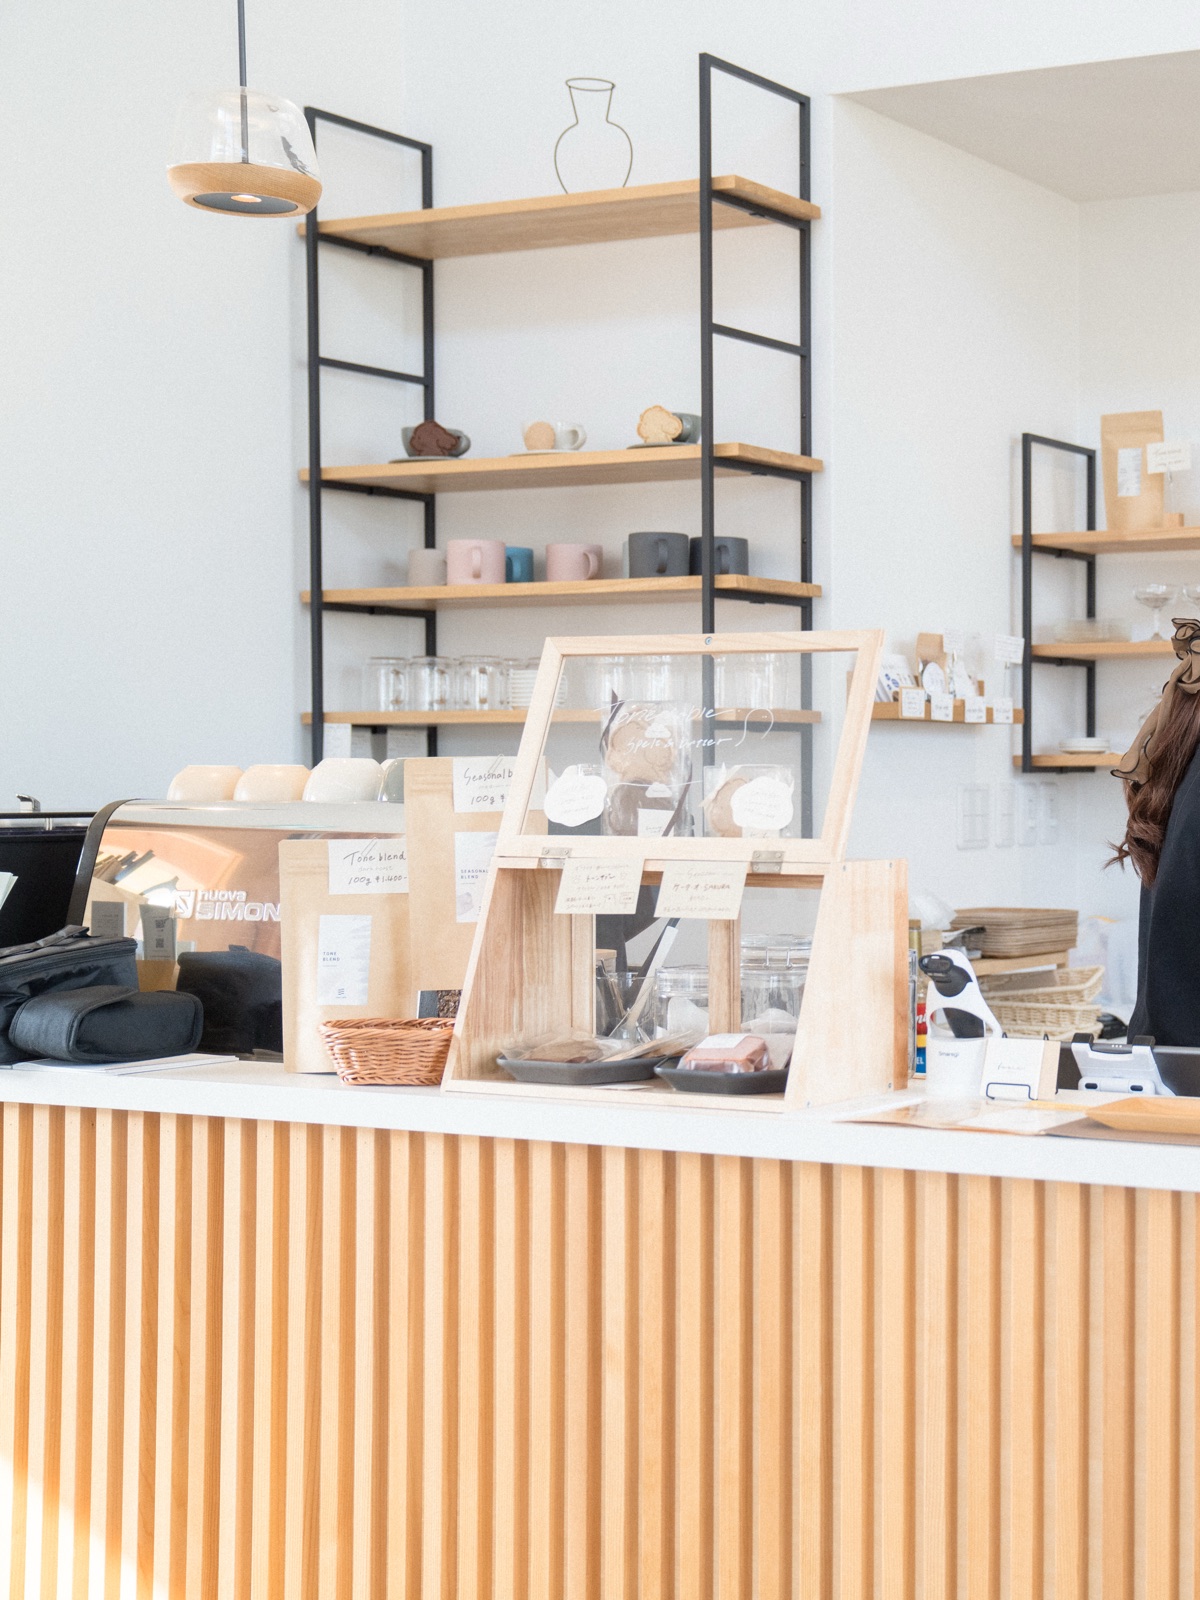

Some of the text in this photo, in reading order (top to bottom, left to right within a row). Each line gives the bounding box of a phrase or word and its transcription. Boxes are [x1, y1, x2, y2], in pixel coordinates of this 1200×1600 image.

[463, 767, 506, 786] Seasonal
[470, 794, 496, 806] 100g
[343, 850, 407, 866] Tone blend
[348, 875, 372, 887] 100g
[197, 889, 247, 902] nuova
